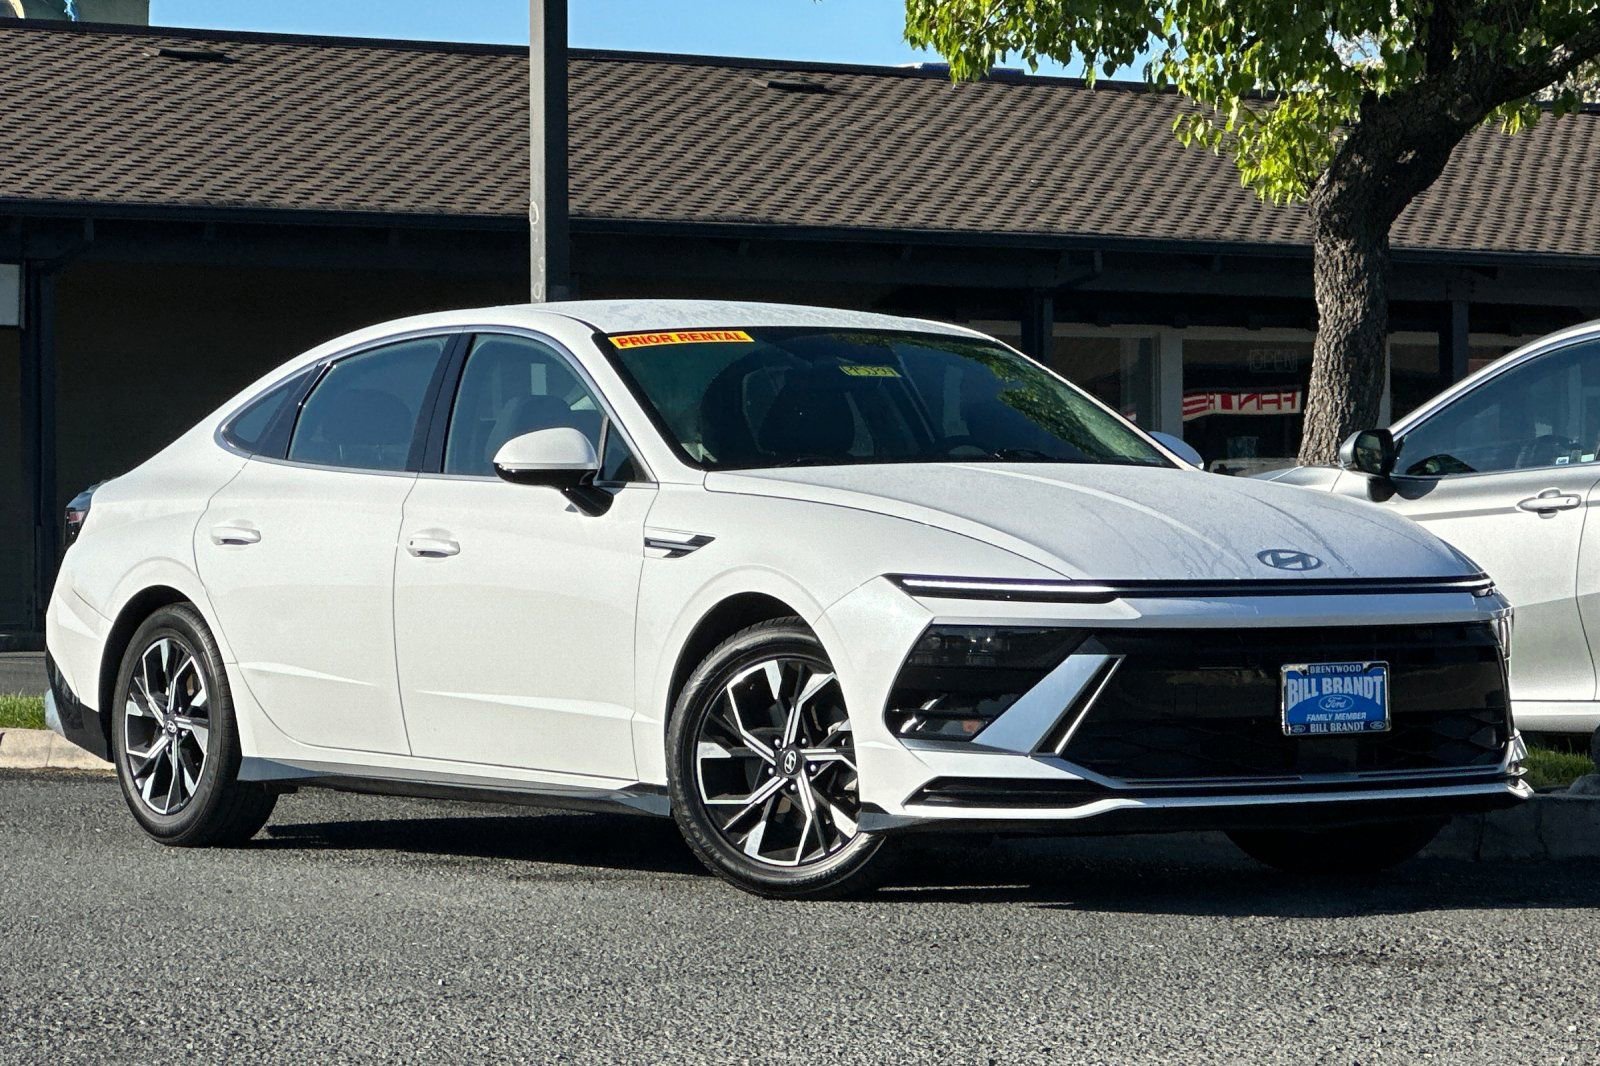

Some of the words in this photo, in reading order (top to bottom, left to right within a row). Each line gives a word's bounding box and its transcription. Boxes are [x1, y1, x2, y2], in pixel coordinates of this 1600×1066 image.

[616, 334, 675, 347] PRIOR
[676, 332, 747, 341] RENTAL
[1253, 351, 1295, 370] OPEN
[1310, 664, 1361, 674] BRENTWOOD
[1287, 678, 1319, 711] BILL
[1322, 675, 1383, 705] BRANDT
[1325, 698, 1347, 709] Ford
[1306, 713, 1332, 722] FAMILY
[1334, 712, 1367, 721] MEMBER
[1310, 723, 1328, 733] BILL
[1330, 721, 1365, 732] BRANDT
